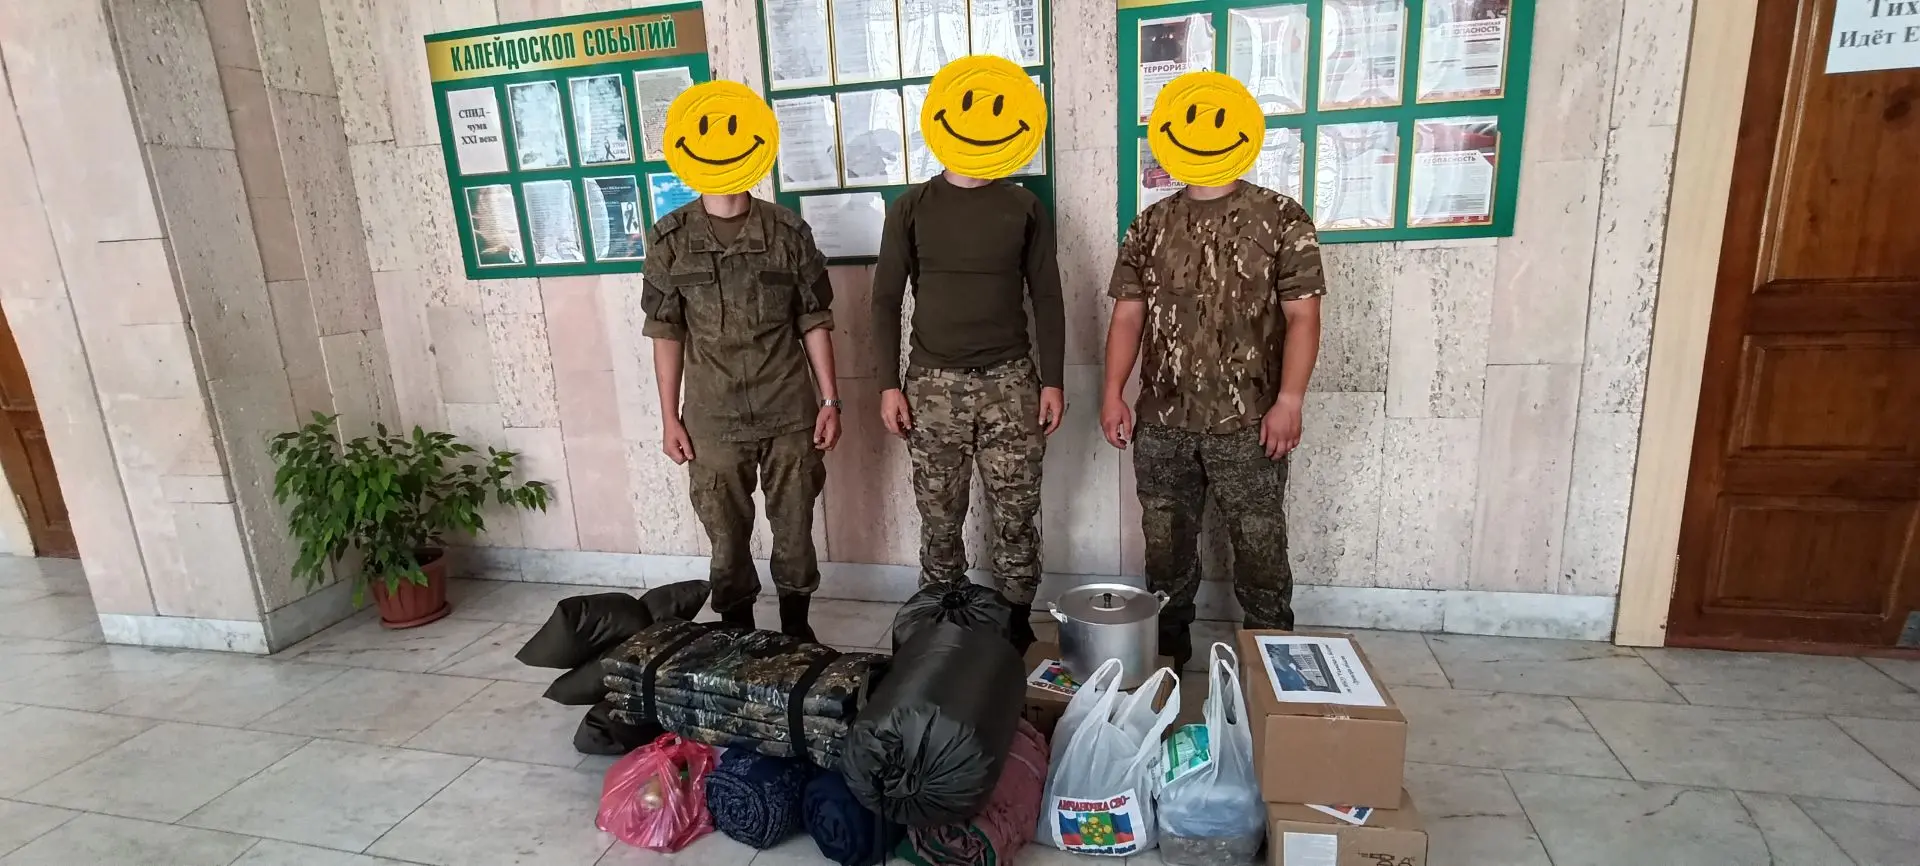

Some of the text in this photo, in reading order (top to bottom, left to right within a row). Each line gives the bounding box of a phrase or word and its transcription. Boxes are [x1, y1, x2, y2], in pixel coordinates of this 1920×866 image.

[583, 14, 677, 57] СОБЫТИЙ
[1440, 26, 1500, 36] ОПАСНОСТЬ
[1838, 25, 1920, 48] Идёт Е
[1144, 63, 1187, 74] ТЕРРОРИЗ
[467, 123, 488, 133] чума
[461, 135, 498, 145] XXI века
